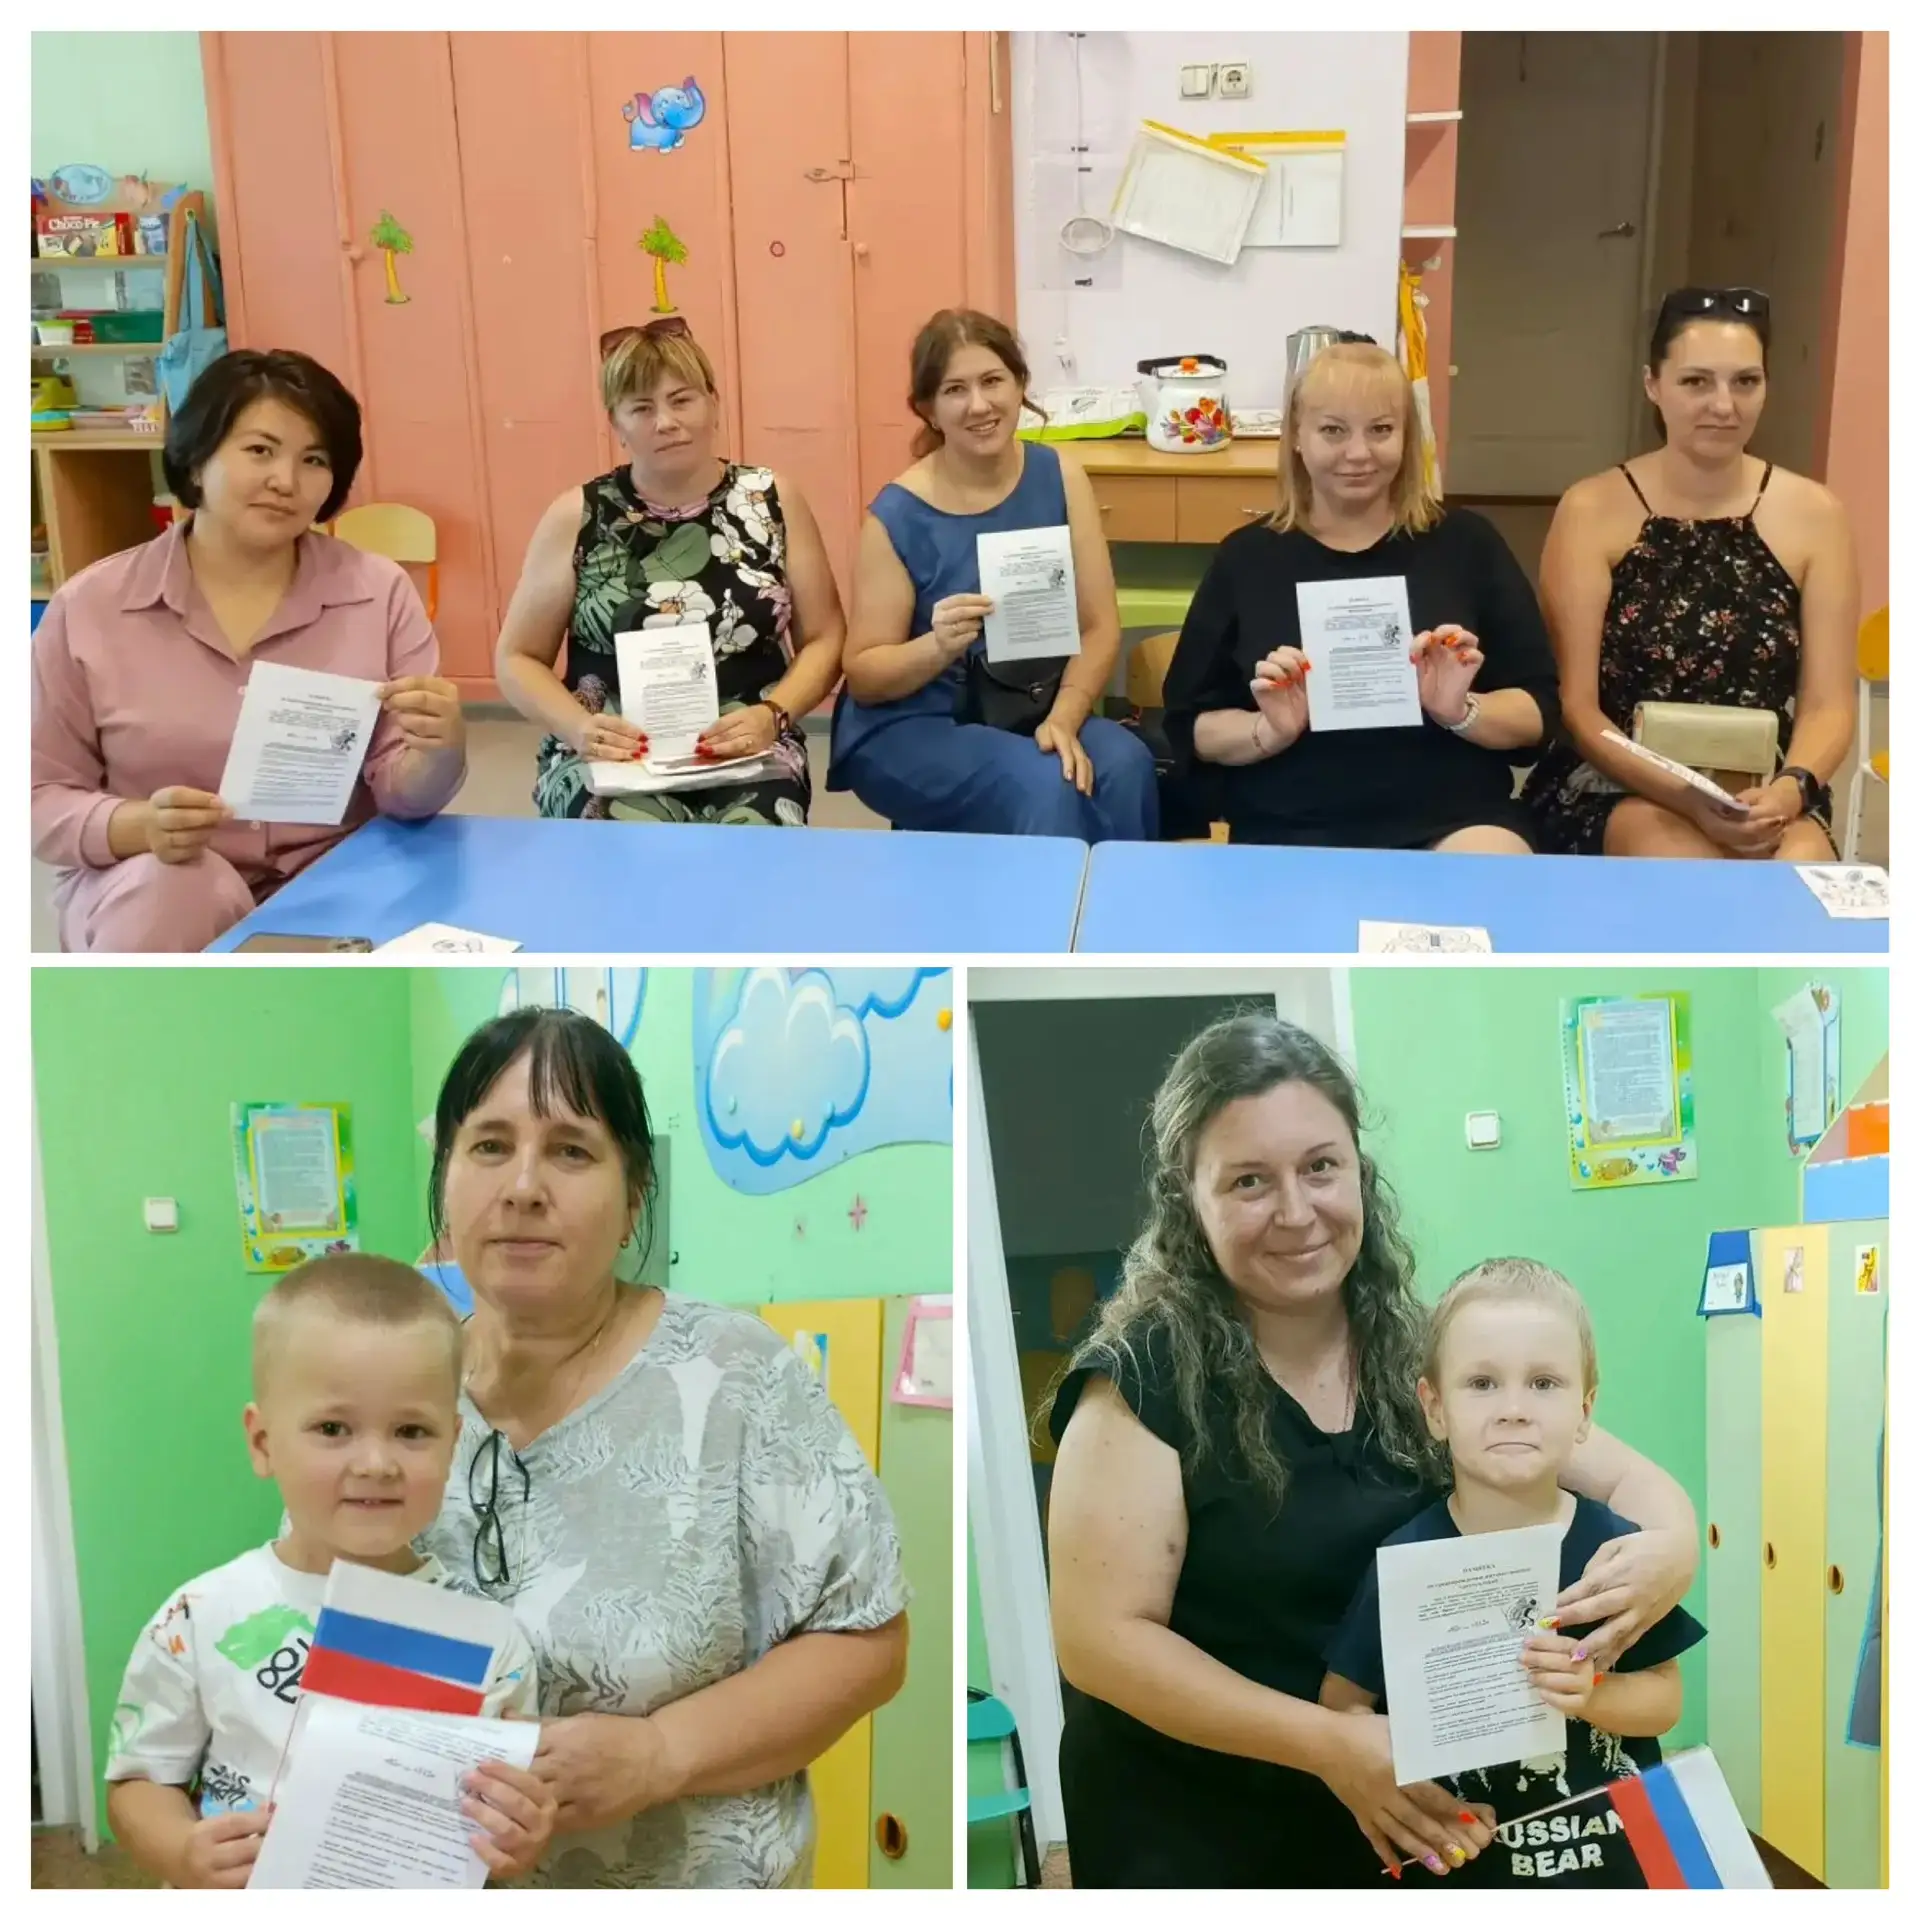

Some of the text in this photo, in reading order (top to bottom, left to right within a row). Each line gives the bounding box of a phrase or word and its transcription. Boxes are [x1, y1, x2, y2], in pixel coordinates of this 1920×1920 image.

[48, 217, 83, 232] Choco
[1494, 1809, 1625, 1849] USSIAN
[1511, 1842, 1605, 1878] BEAR
